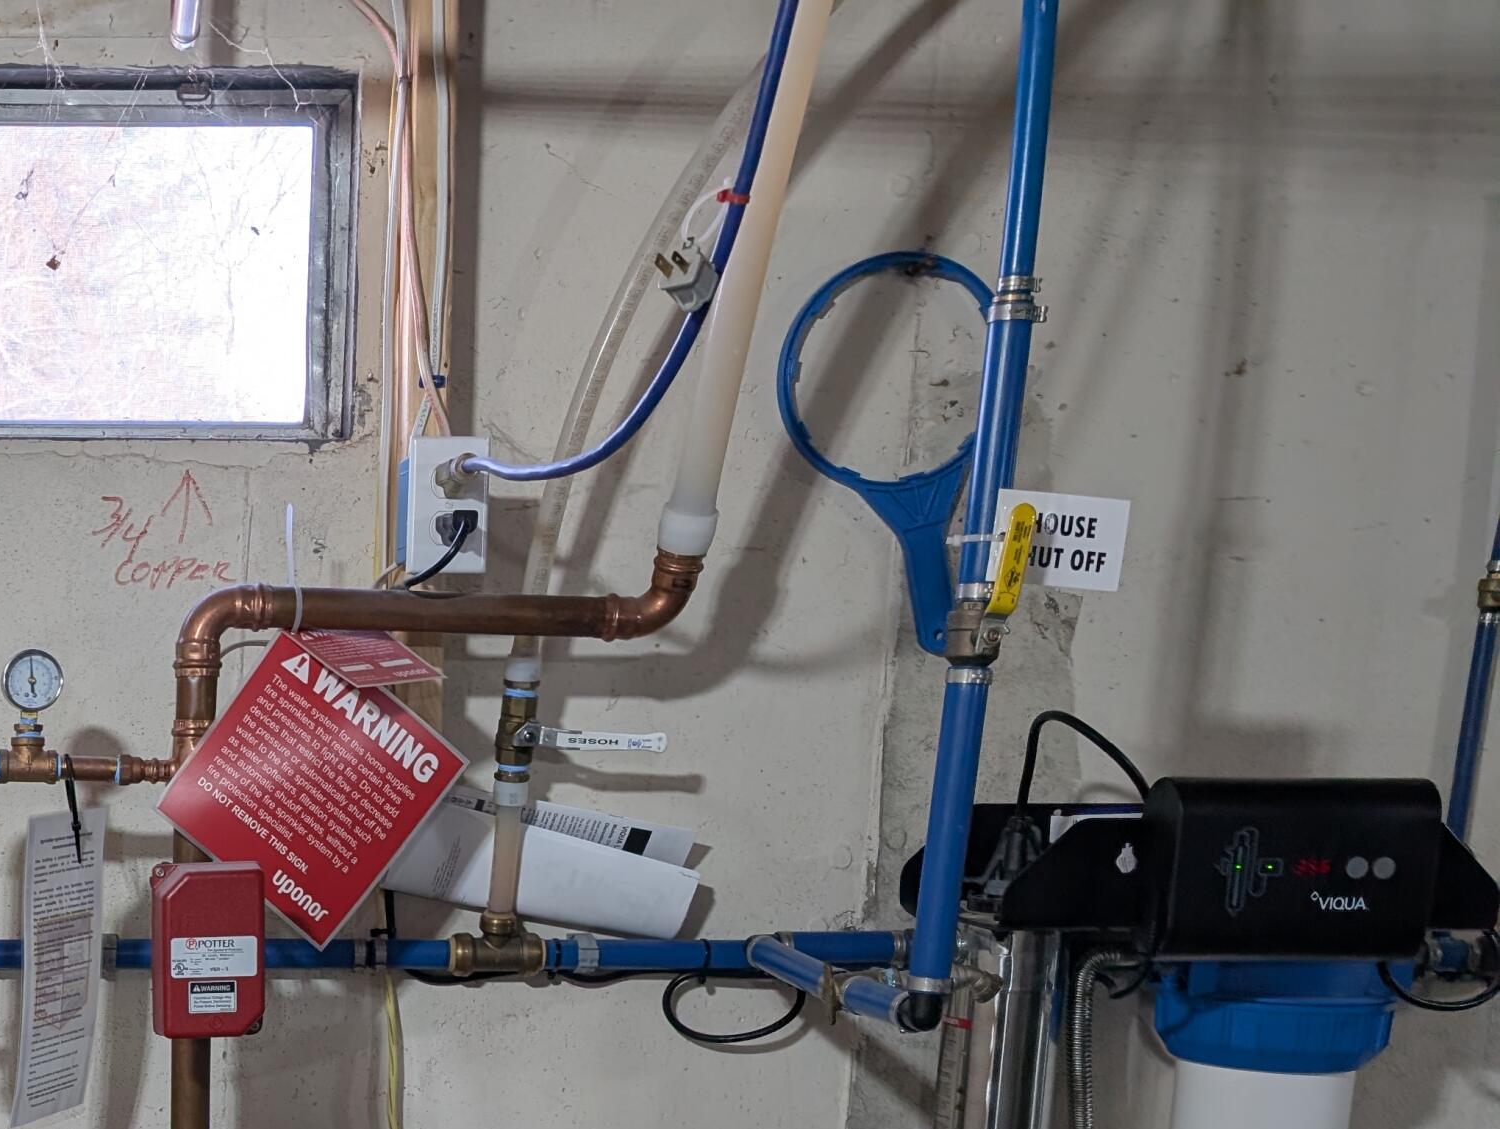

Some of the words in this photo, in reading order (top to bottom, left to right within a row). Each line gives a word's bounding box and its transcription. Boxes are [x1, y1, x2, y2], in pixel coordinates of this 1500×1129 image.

[92, 496, 154, 561] 3/4
[115, 556, 237, 589] COPPER
[1070, 549, 1107, 573] OFF
[250, 706, 279, 732] devices
[280, 729, 296, 746] that
[296, 744, 322, 767] restrict
[322, 764, 335, 778] the
[335, 776, 351, 792] flow
[360, 799, 392, 828] decrease
[257, 696, 274, 710] and
[272, 709, 311, 744] pressures
[320, 747, 338, 764] fight
[344, 767, 357, 782] fire.
[371, 792, 384, 805] not
[383, 803, 399, 817] add
[264, 684, 277, 698] fire
[278, 697, 314, 729] sprinklers
[315, 727, 332, 743] that
[331, 741, 357, 765] require
[358, 764, 382, 787] certain
[383, 784, 401, 804] flows
[272, 674, 287, 691] The
[289, 689, 311, 709] water
[311, 708, 338, 733] system
[339, 730, 350, 742] for
[350, 740, 364, 755] this
[364, 752, 385, 773] home
[386, 772, 415, 800] supplies
[313, 668, 438, 782] WARNING
[567, 737, 619, 745] HOSES
[207, 765, 219, 779] fire
[218, 777, 257, 810] protection
[258, 809, 292, 841] specialist.
[214, 756, 240, 778] review
[249, 784, 262, 797] the
[262, 795, 275, 809] fire
[276, 808, 307, 835] sprinkler
[307, 834, 332, 858] system
[221, 746, 238, 761] and
[237, 760, 274, 791] automatic
[275, 790, 302, 813] shutoff
[301, 812, 324, 836] valves,
[326, 834, 352, 858] without
[236, 725, 258, 745] water
[267, 751, 280, 765] the
[281, 762, 293, 776] fire
[294, 775, 326, 802] sprinkler
[326, 801, 352, 828] system,
[353, 826, 371, 843] such
[240, 745, 262, 766] water
[260, 763, 296, 796] softeners,
[299, 794, 327, 821] filtration
[328, 820, 357, 849] systems,
[243, 714, 256, 728] the
[256, 728, 290, 757] pressure
[300, 762, 347, 805] automatically
[347, 804, 364, 820] shut
[364, 819, 376, 829] off
[374, 826, 386, 840] the
[212, 788, 233, 806] NOT
[232, 805, 268, 838] REMOVE
[269, 835, 287, 854] THIS
[287, 852, 308, 873] SIGN.
[273, 870, 328, 921] uponor
[1319, 897, 1366, 911] VIQUA
[198, 940, 235, 949] POTTER
[200, 984, 231, 992] WARNING
